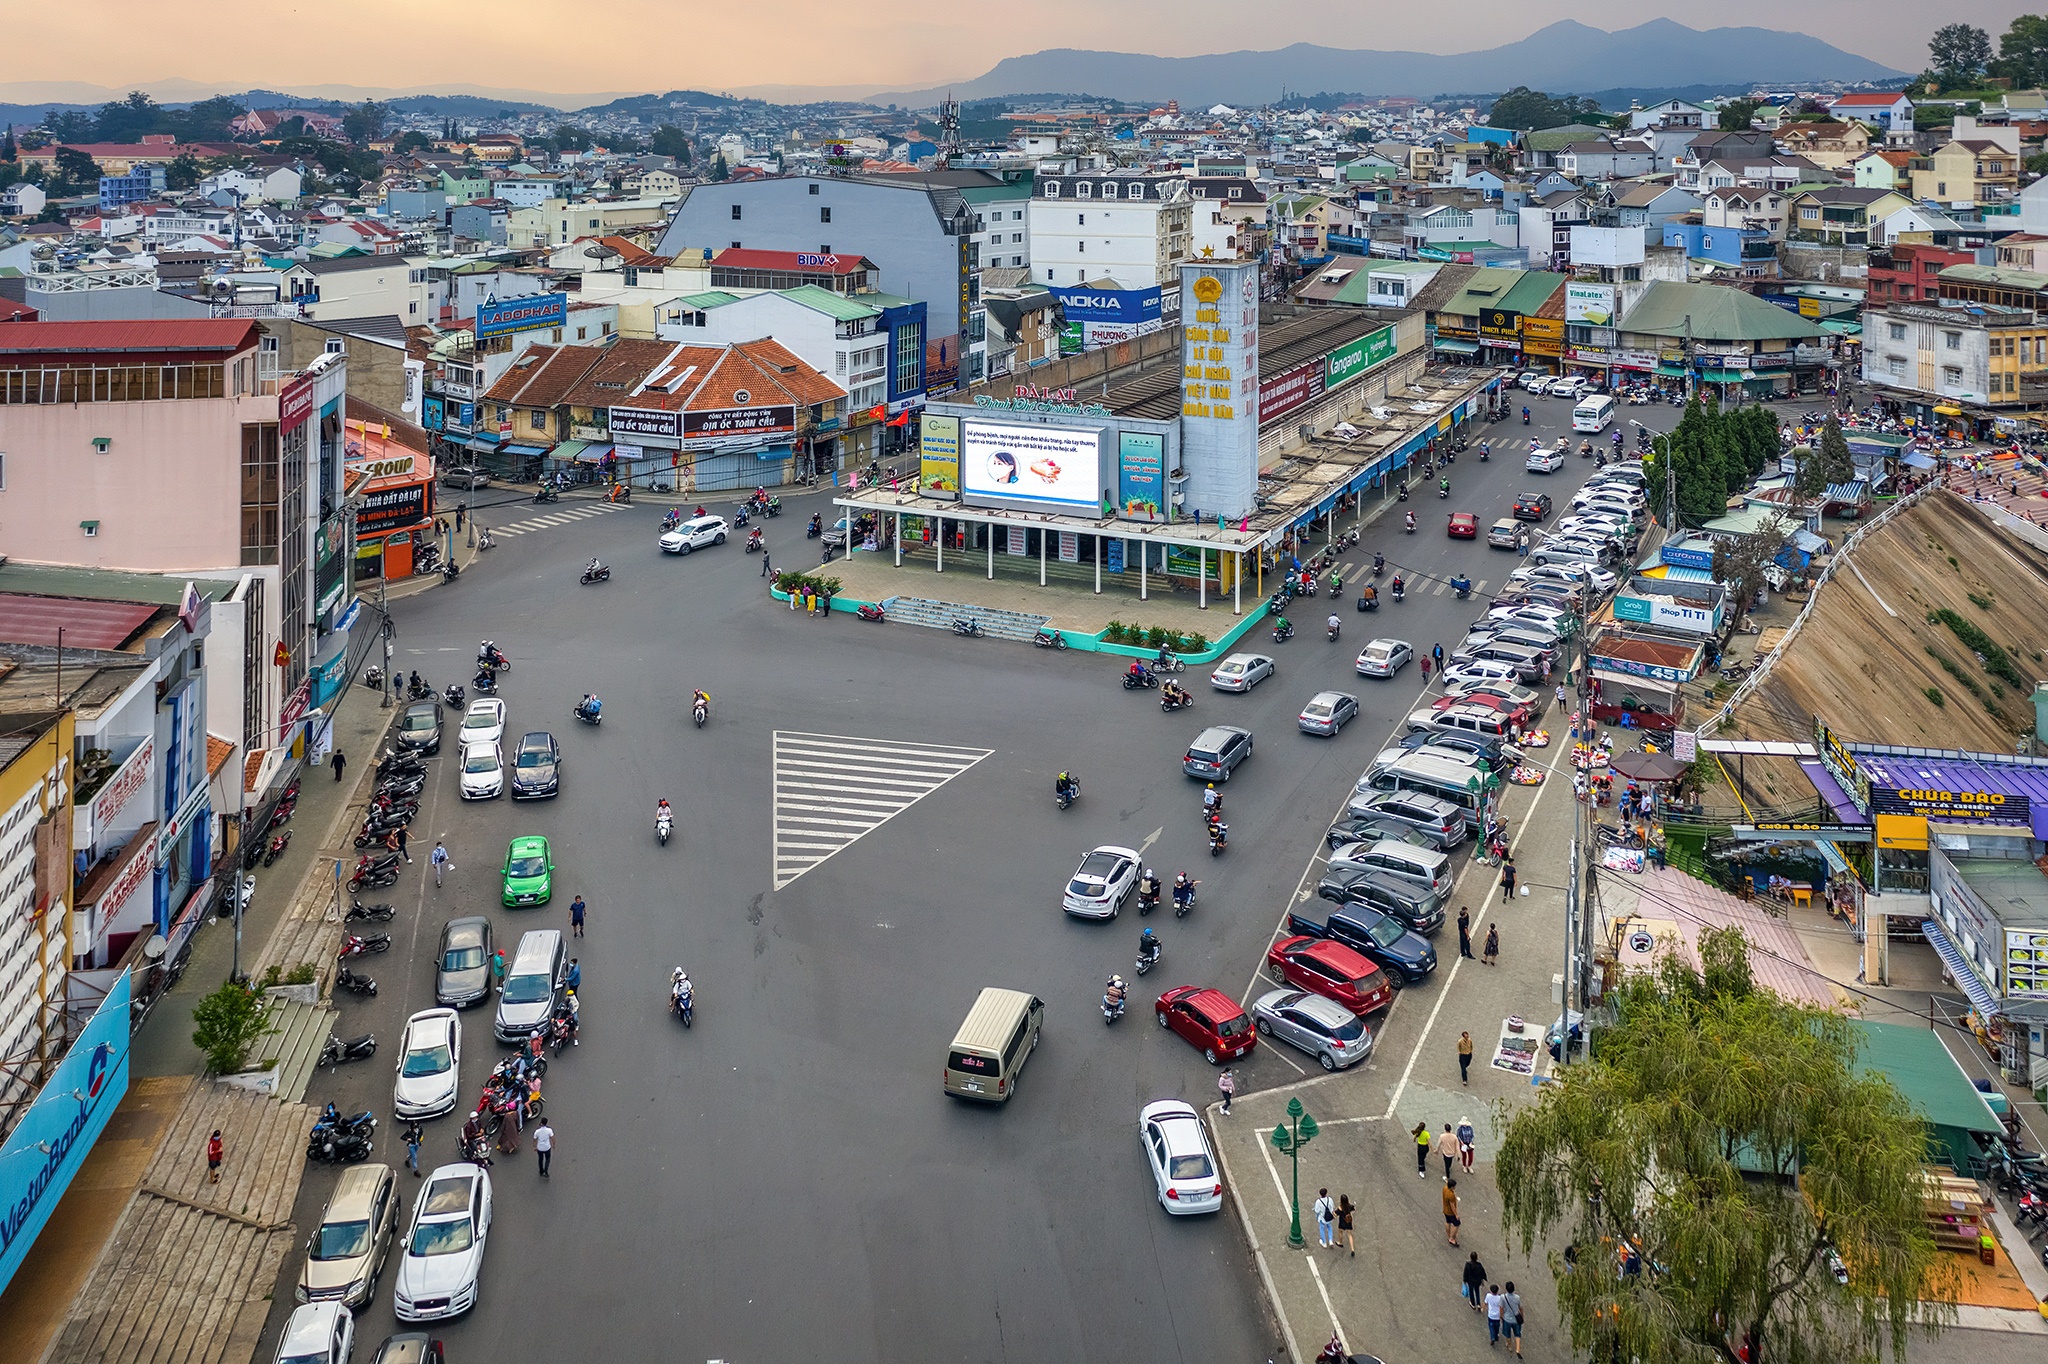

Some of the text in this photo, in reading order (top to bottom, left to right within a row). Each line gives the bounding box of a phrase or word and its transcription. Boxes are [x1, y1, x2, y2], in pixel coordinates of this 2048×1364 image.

[797, 253, 826, 266] BIDV
[1570, 290, 1603, 299] VinaLatex
[1059, 295, 1121, 309] NOKIA
[1143, 297, 1159, 307] NOKIA
[483, 304, 560, 325] LADOPHAR
[1195, 310, 1221, 323] NƯỚC
[1092, 330, 1127, 340] PHƯƠNG
[1186, 327, 1210, 344] CỘNG
[1208, 347, 1223, 364] HỘI
[1703, 357, 1720, 367] Tiger
[1327, 350, 1362, 377] Kangaroo
[1184, 363, 1232, 380] CHỦ NGHĨA
[1015, 383, 1077, 402] ĐÀ LẠT
[1186, 384, 1231, 400] VIỆT NAM
[1183, 402, 1234, 419] MUÔN NĂM
[626, 419, 637, 430] ỐC
[638, 422, 658, 433] TOÀN
[720, 419, 732, 429] ỐC
[735, 419, 756, 427] TOÀN
[1624, 601, 1642, 609] Grab
[1660, 607, 1705, 620] Shop Ti Ti
[1650, 667, 1676, 680] 45
